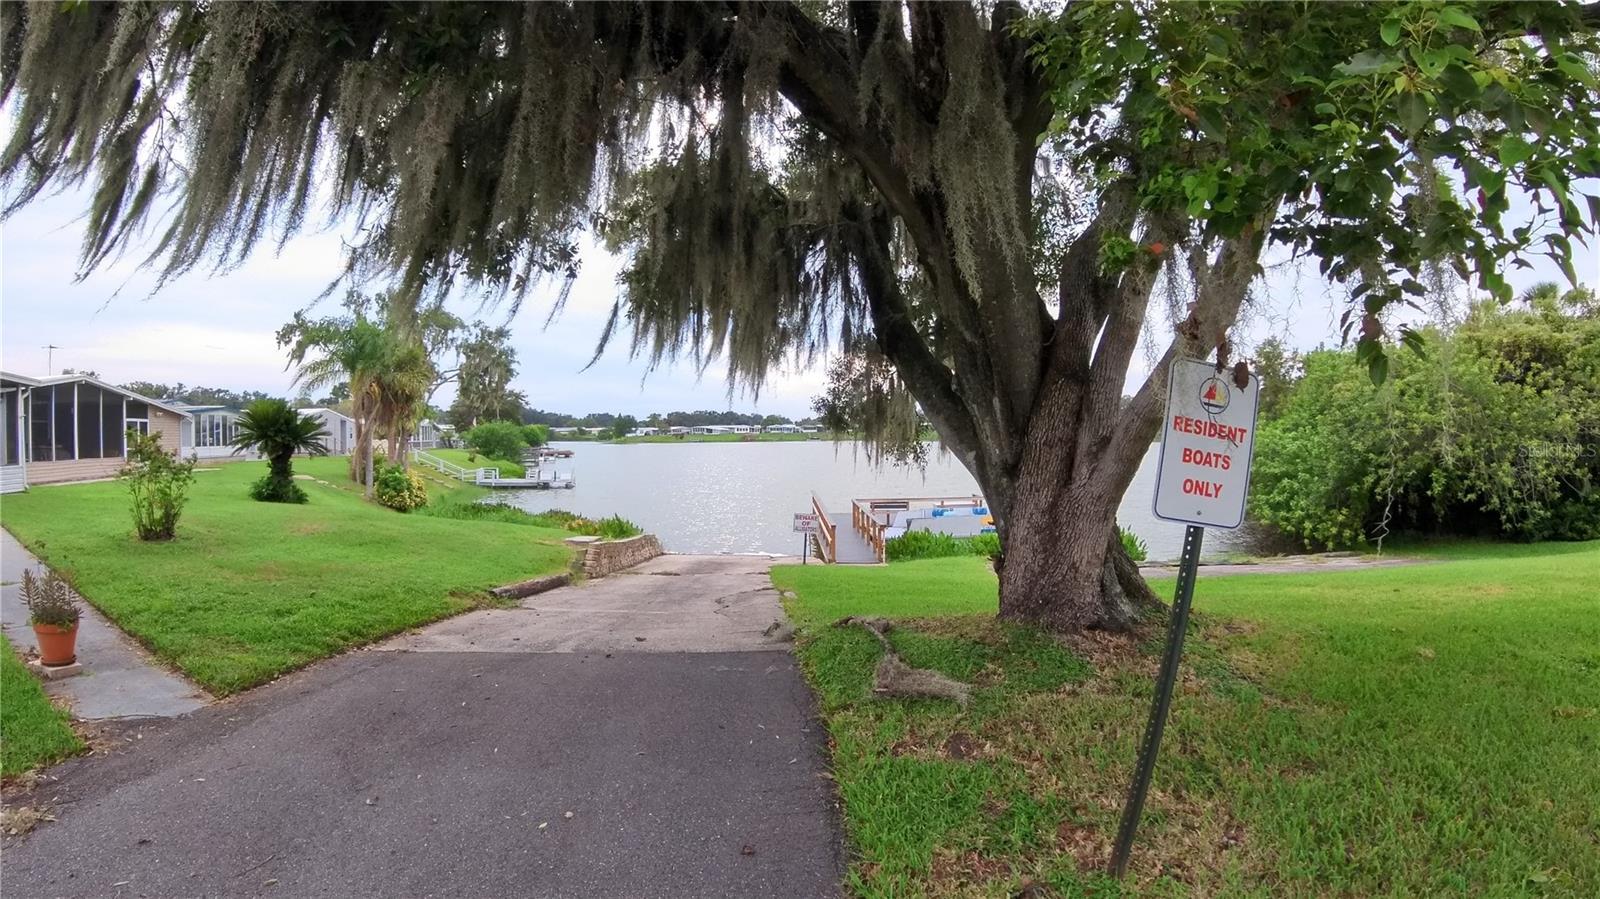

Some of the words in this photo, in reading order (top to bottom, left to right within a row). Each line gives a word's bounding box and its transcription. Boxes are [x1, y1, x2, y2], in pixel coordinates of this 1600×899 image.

[1173, 415, 1247, 443] RESIDENT
[1182, 448, 1231, 470] BOATS
[1183, 478, 1223, 498] ONLY
